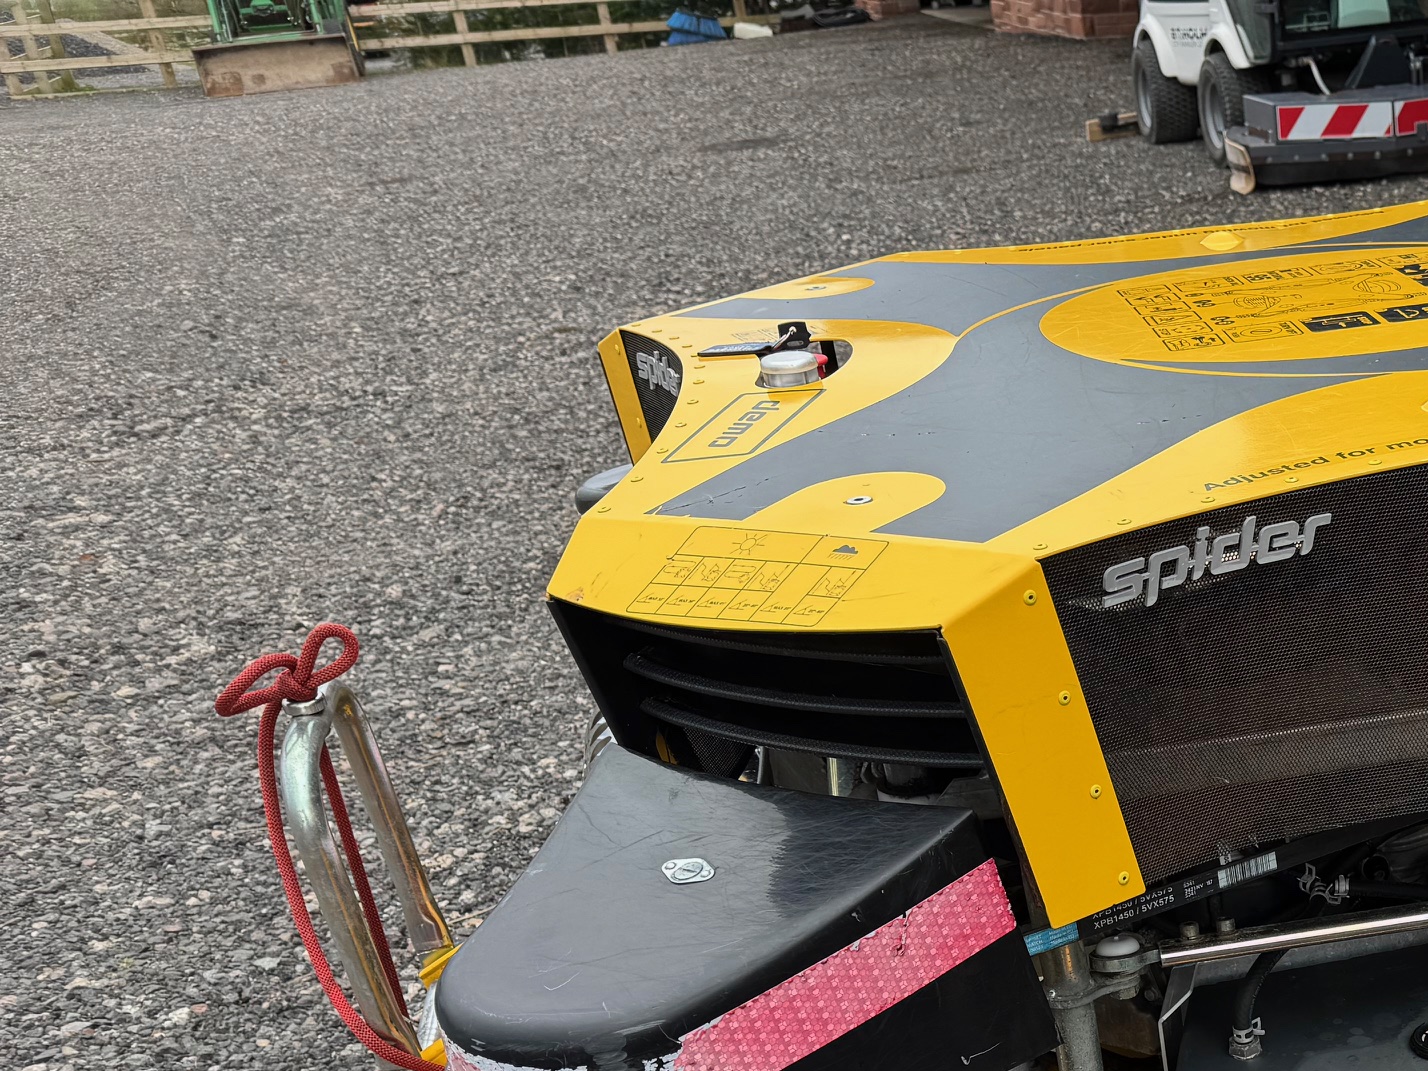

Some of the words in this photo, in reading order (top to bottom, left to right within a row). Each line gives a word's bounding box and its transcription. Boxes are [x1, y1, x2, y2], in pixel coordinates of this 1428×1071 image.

[708, 399, 780, 449] demo
[1204, 456, 1329, 491] Adjusted
[1335, 446, 1376, 461] for
[1102, 512, 1332, 608] spider
[1094, 908, 1134, 929] XPB1450
[1141, 894, 1175, 912] 5VX575
